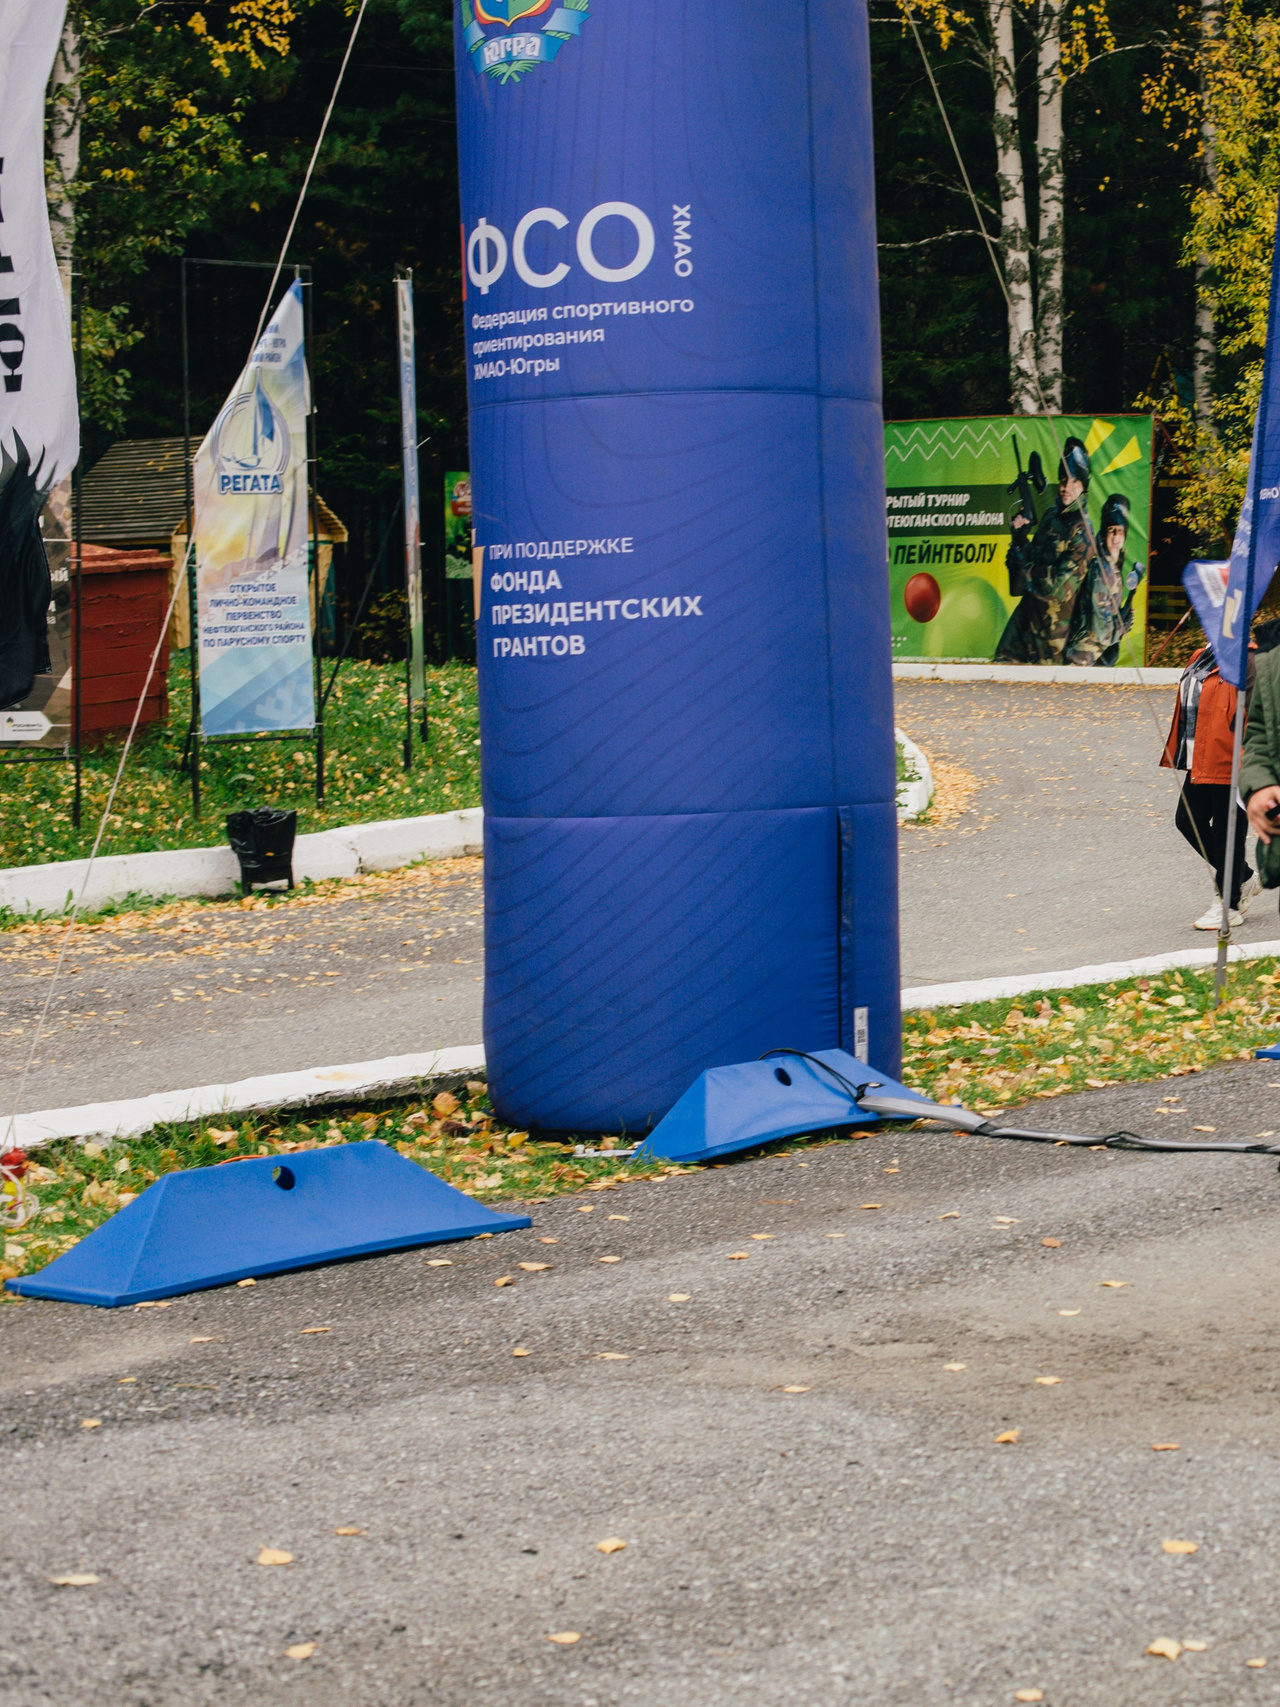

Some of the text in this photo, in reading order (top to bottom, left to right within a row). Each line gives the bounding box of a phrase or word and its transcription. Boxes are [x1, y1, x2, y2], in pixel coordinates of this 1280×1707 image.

[467, 201, 655, 295] ФСО
[672, 204, 693, 278] ХМАО
[472, 298, 695, 330] Федерация спортивного
[472, 328, 605, 359] ориентирования
[473, 357, 560, 380] ХМАО-Югры
[220, 474, 281, 492] РЕГАТА
[887, 492, 970, 508] РЫТЫЙ ТУРНИР
[887, 511, 1004, 528] ТЕЮГАНСКОГО РАЙОНА
[489, 537, 634, 560] ПРИ ПОДДЕРЖКЕ
[894, 540, 997, 565] ПЕЙНТБОЛУ
[490, 569, 563, 594] ФОНДА
[491, 595, 703, 626] ПРЕЗИДЕНТСКИХ
[493, 635, 586, 657] ГРАНТОВ
